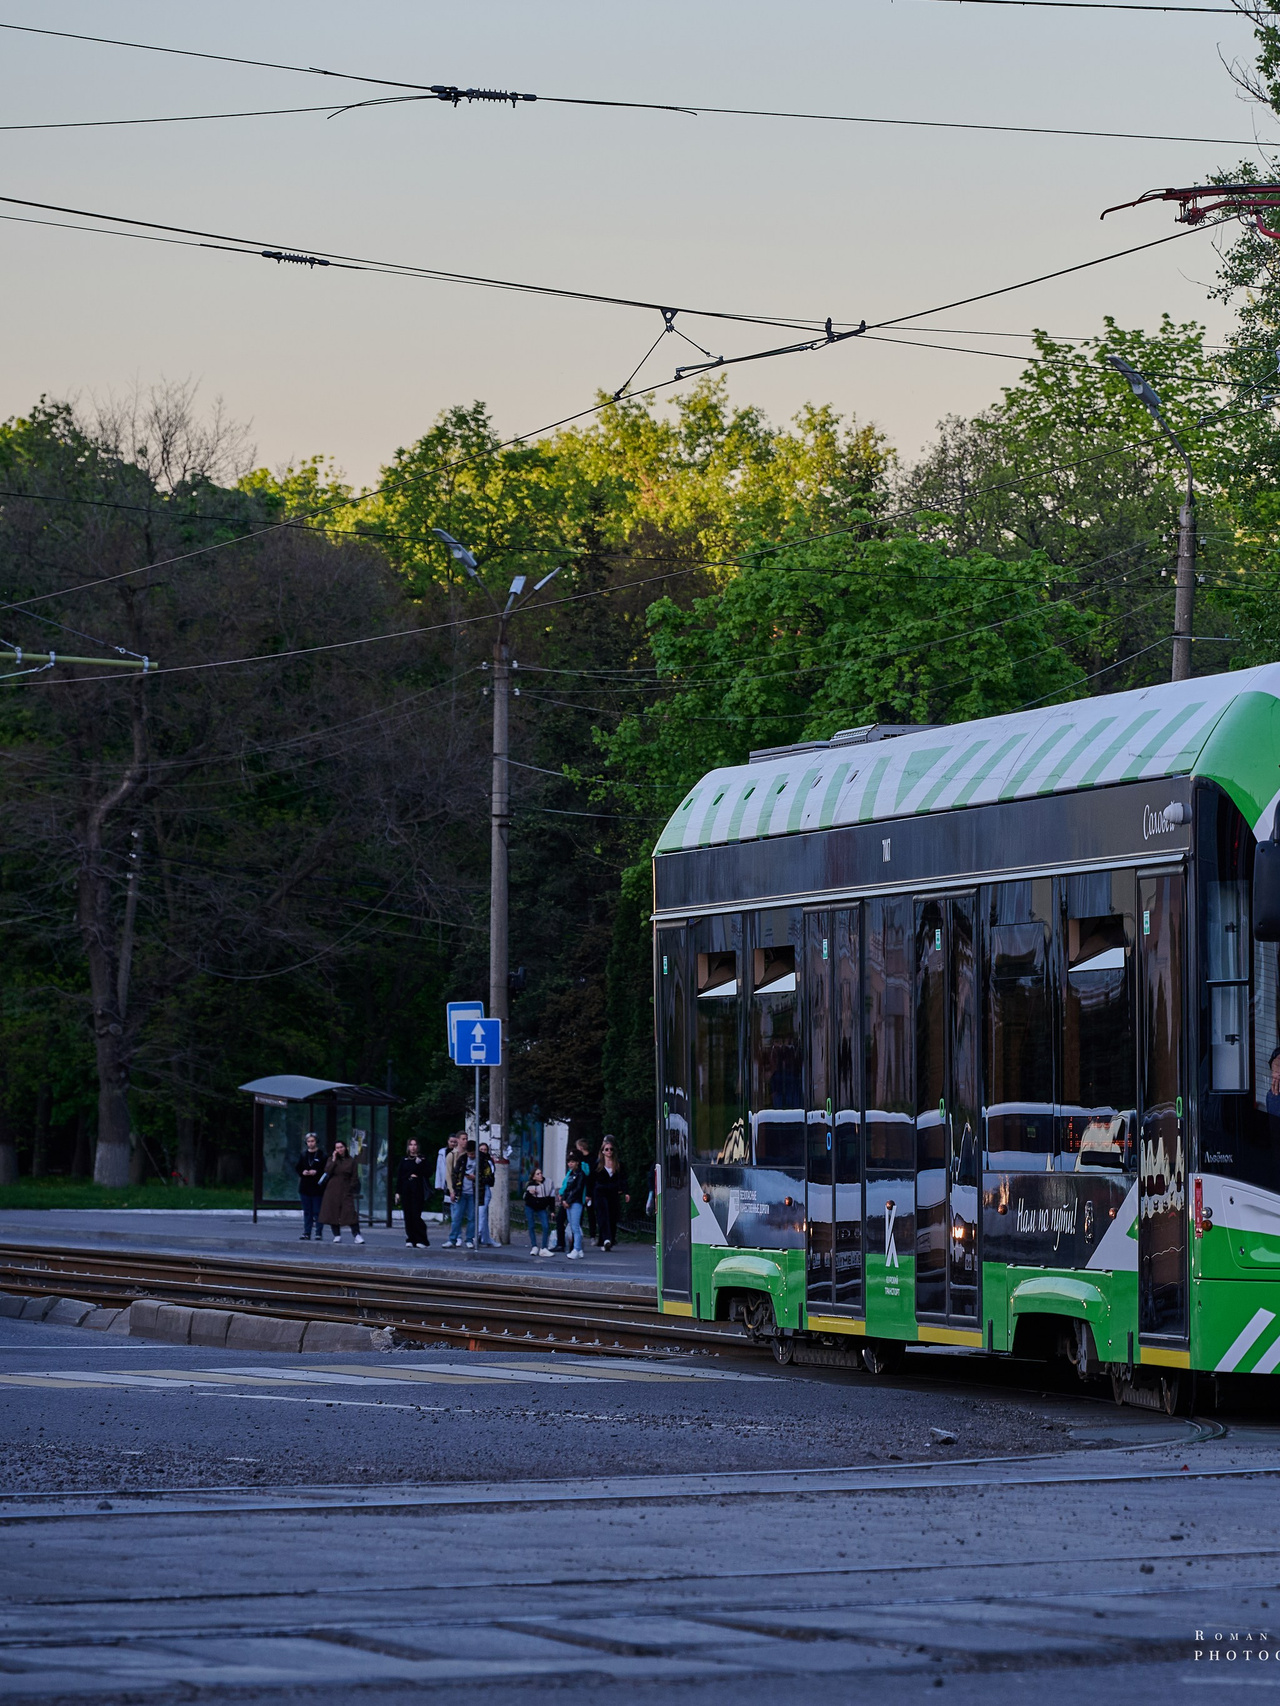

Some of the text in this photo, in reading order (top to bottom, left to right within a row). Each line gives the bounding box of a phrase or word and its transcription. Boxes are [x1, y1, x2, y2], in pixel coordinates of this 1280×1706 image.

[1204, 1151, 1233, 1163] Львёнок
[1016, 1197, 1078, 1251] Нам по пути!
